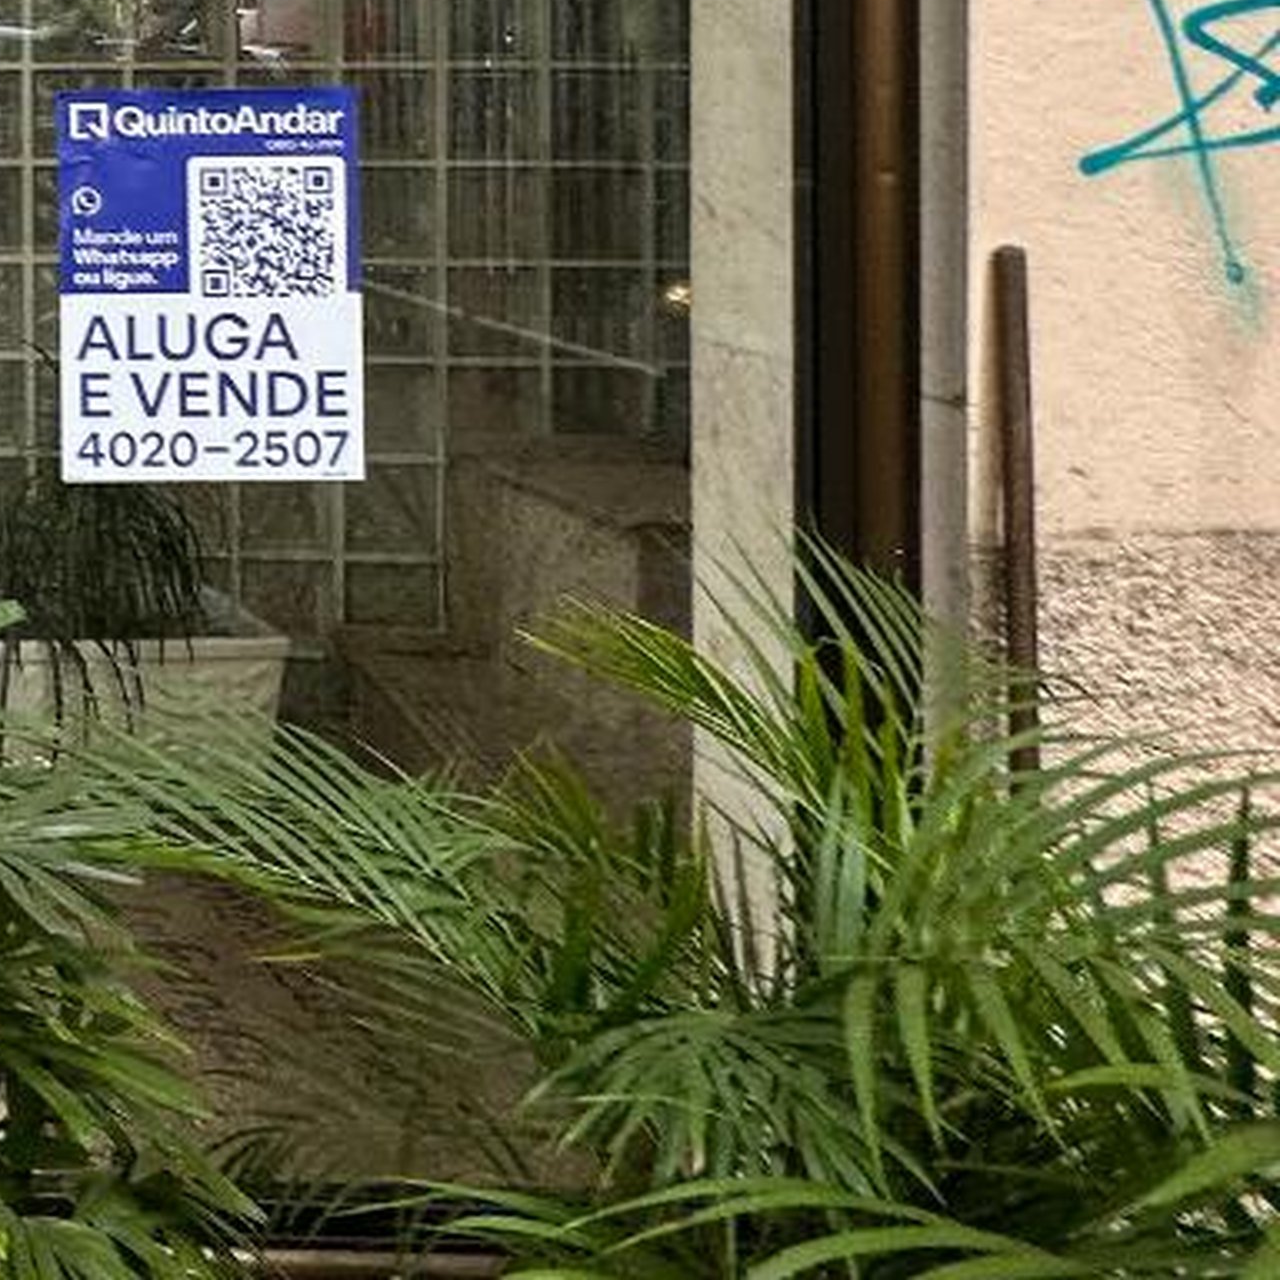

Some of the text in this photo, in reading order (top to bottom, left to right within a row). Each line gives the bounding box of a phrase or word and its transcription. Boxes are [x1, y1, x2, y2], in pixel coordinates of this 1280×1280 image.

[113, 104, 344, 138] QuintoAndar
[73, 228, 178, 245] Mande um
[73, 272, 100, 285] ou
[76, 312, 299, 361] ALUGA
[80, 371, 348, 418] E VENDE
[77, 430, 350, 468] 4020-2507
